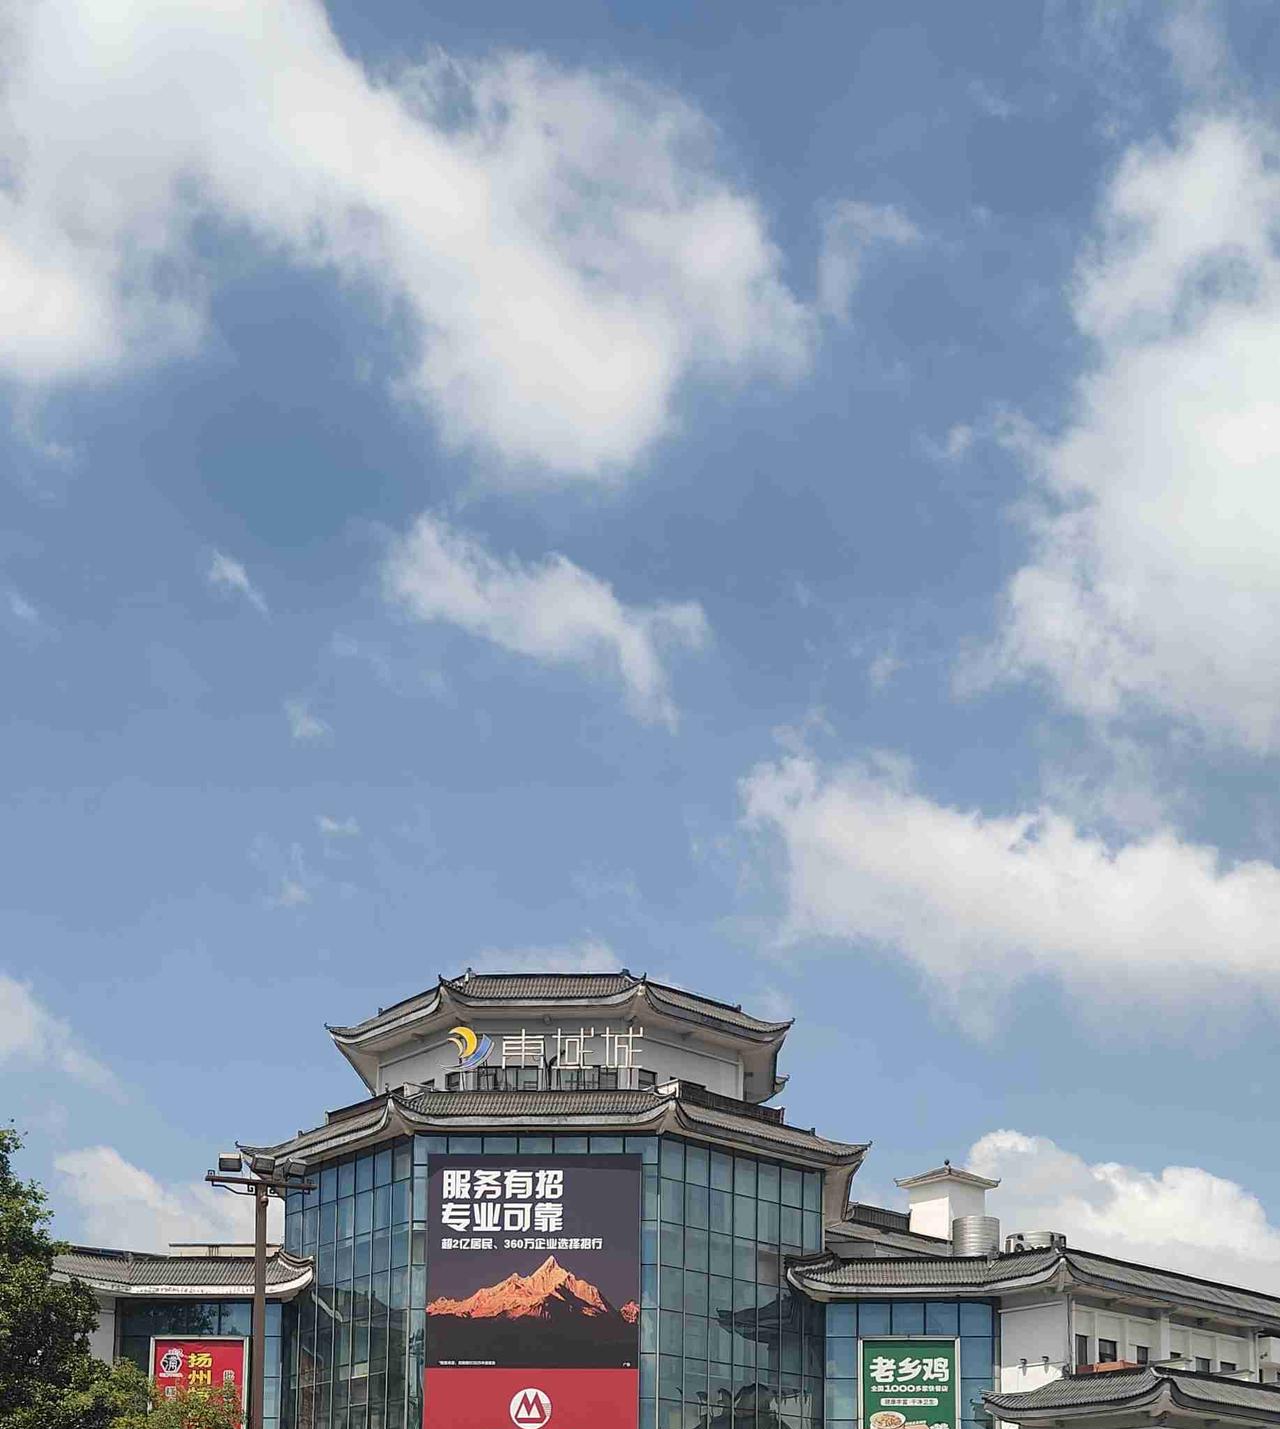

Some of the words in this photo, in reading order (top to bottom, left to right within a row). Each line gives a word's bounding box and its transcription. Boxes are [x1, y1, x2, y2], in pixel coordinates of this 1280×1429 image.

[442, 1169, 564, 1199] 服务有招
[441, 1202, 564, 1232] 专业可靠
[869, 1356, 949, 1383] 老乡鸡
